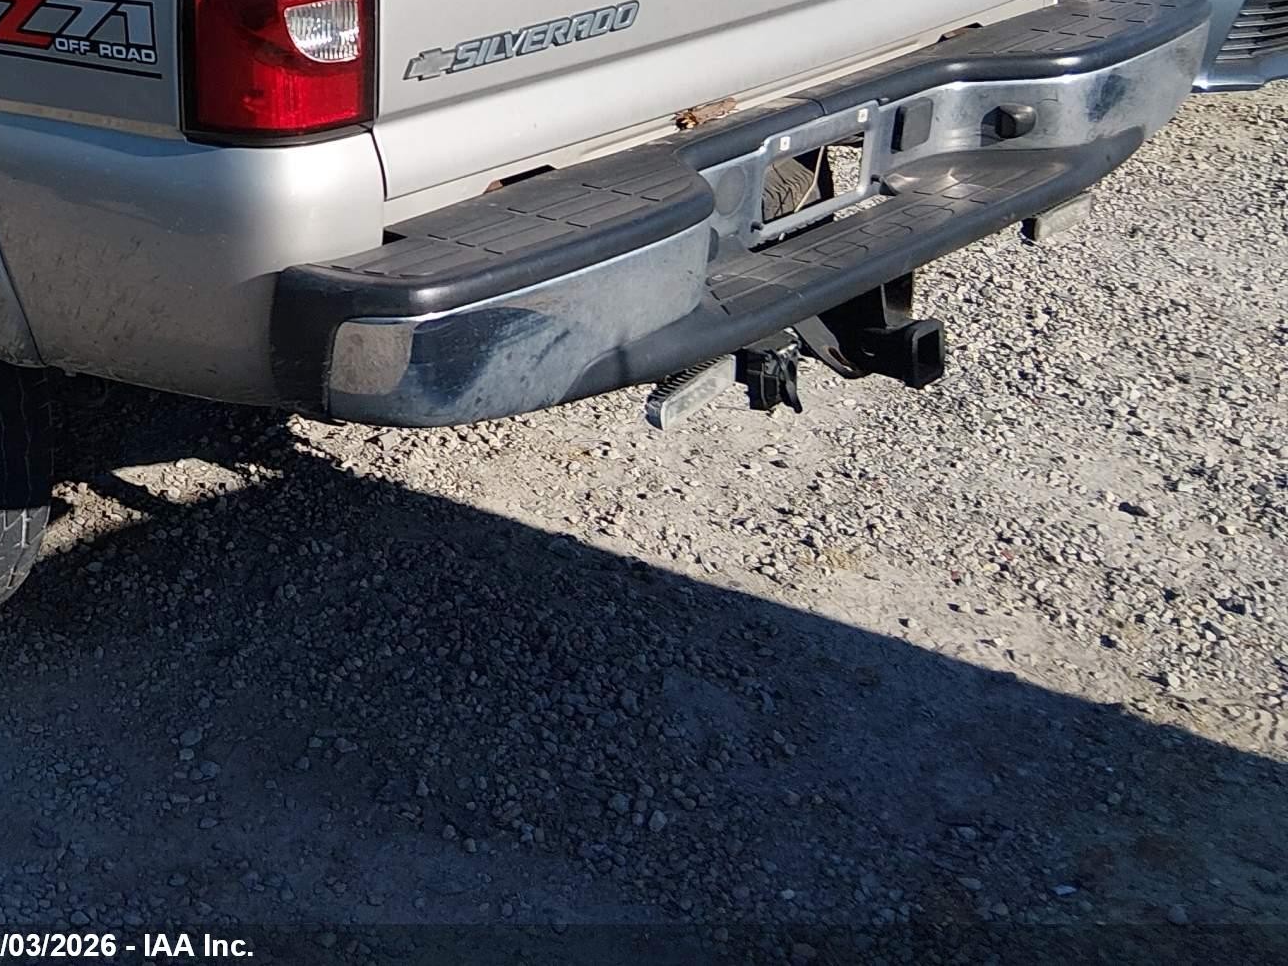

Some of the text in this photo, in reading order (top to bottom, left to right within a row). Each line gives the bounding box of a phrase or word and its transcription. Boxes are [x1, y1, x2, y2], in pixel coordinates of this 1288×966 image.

[54, 37, 158, 64] OFF ROAD
[453, 0, 641, 71] SILVERADO
